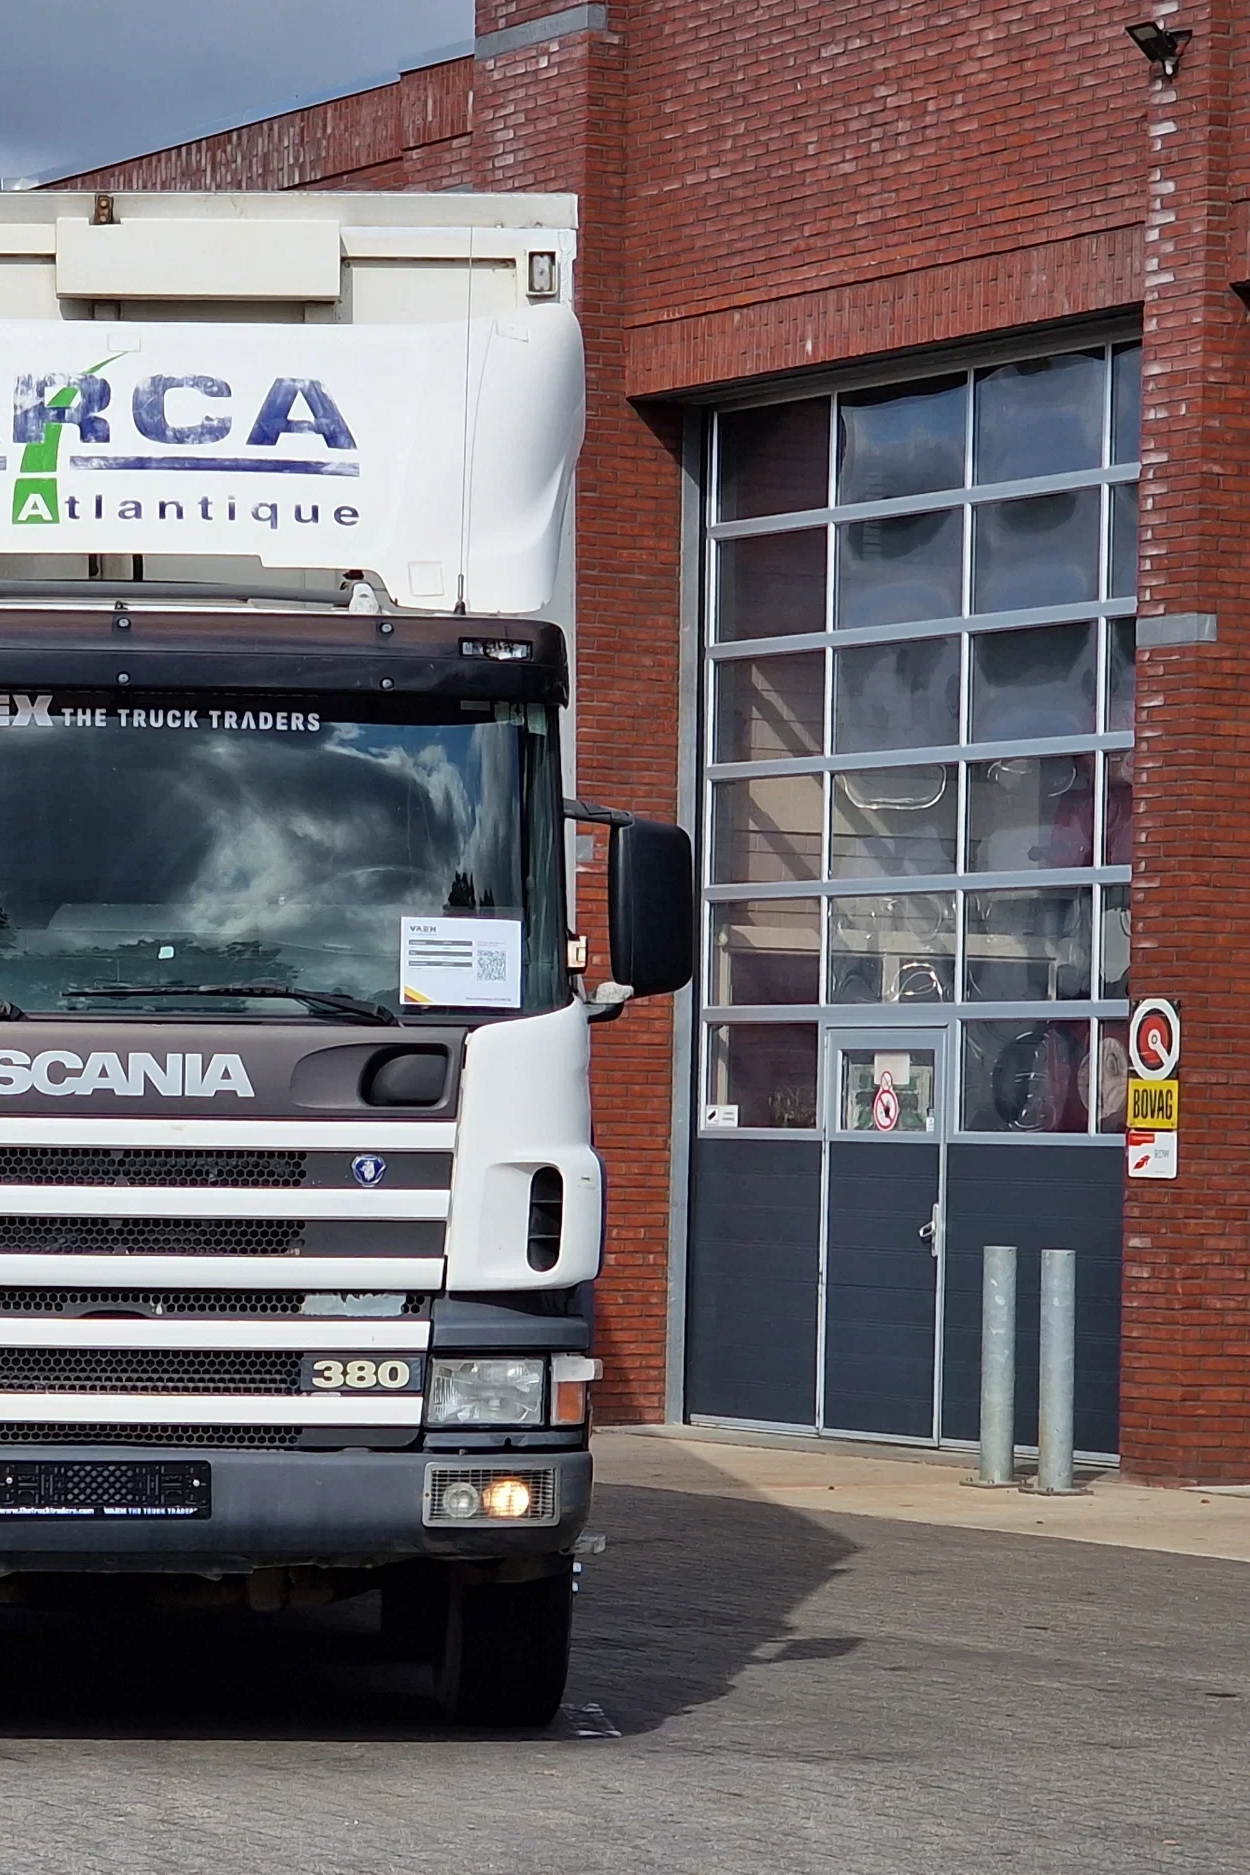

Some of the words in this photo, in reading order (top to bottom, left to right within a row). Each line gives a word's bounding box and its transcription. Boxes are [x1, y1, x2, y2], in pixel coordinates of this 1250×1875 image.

[16, 493, 360, 529] Atlantique
[62, 708, 106, 727] THE
[117, 708, 198, 729] TRUCK
[209, 709, 320, 731] TRADERS
[1133, 1088, 1173, 1120] BOVAG
[312, 1360, 410, 1389] 380
